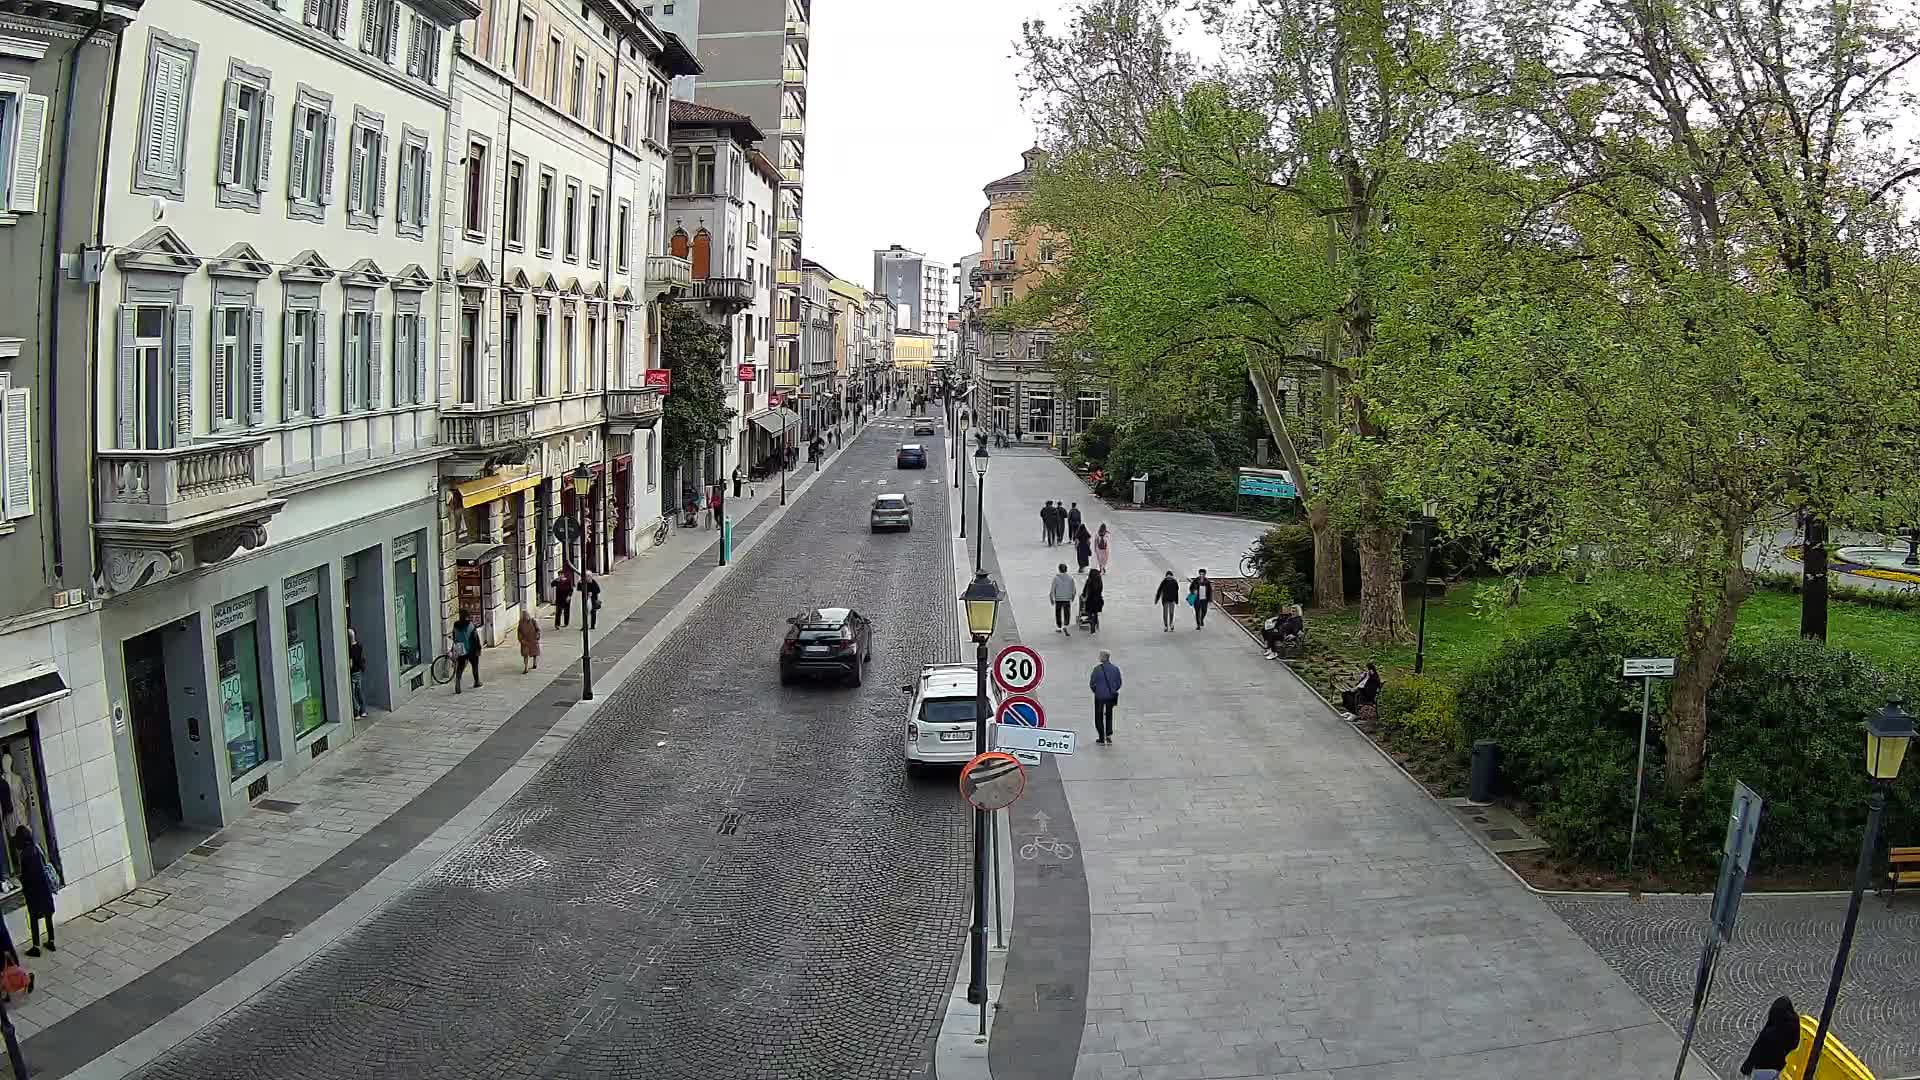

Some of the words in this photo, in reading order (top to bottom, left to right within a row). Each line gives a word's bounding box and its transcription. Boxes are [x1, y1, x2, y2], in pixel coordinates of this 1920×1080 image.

[1005, 658, 1032, 680] 30
[221, 678, 240, 699] 130
[1038, 738, 1069, 750] Dante
